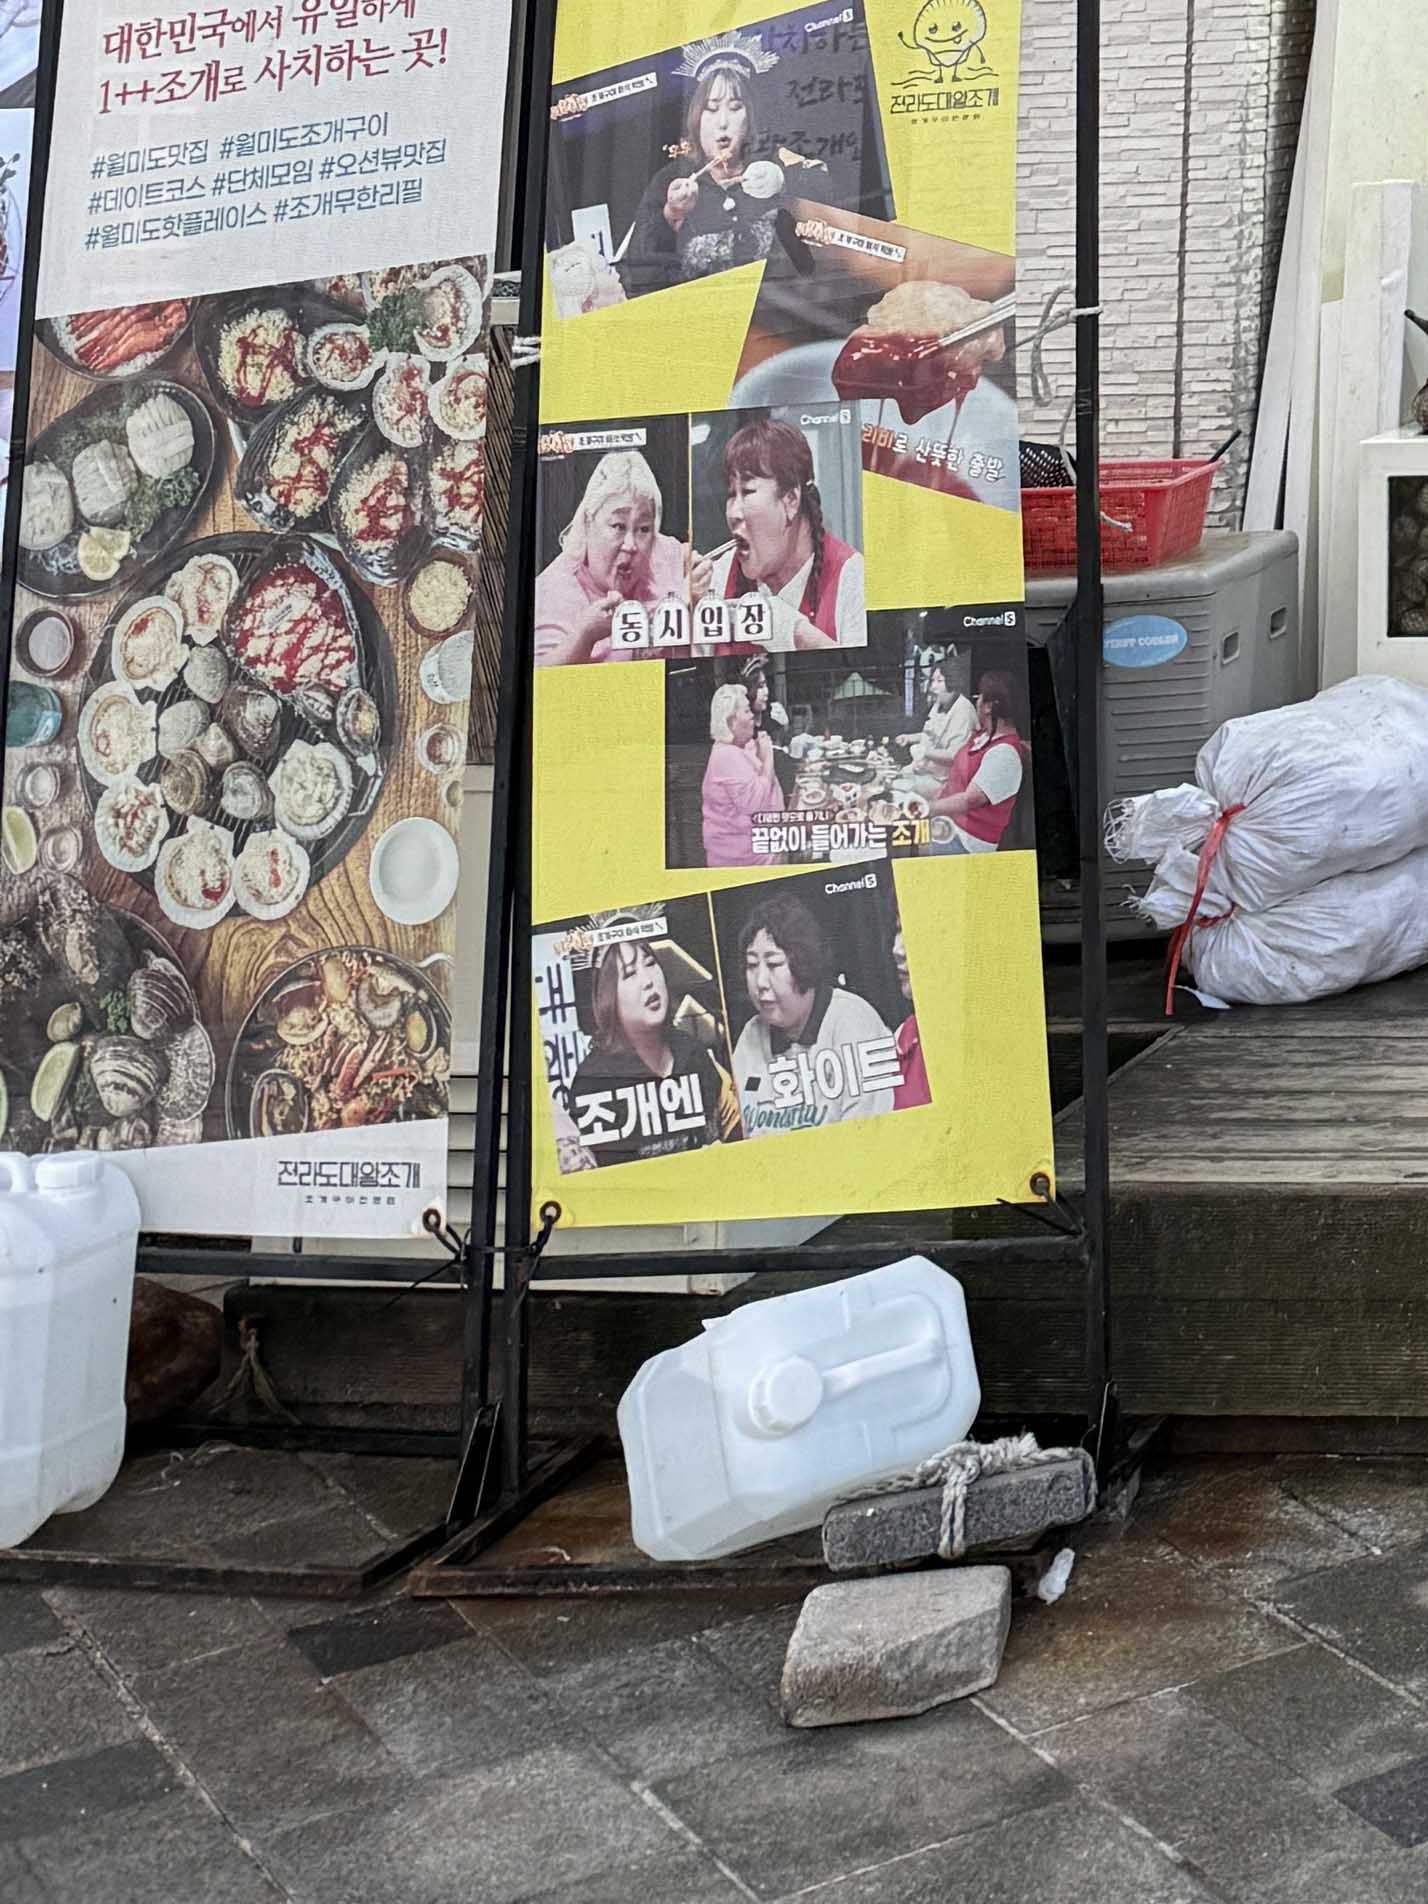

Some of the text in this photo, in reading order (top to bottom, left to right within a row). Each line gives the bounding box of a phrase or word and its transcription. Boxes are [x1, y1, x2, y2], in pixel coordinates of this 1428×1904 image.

[99, 27, 449, 114] 1++조개로 사치하는 곳!
[103, 5, 284, 64] 대한민국에서
[88, 138, 447, 216] #데이트코스 #단체모임 #오션뷰맛집
[91, 111, 389, 180] #월미도맛집 #월미도조개구이
[84, 176, 424, 251] #월미도핫플레이스 #조개무한리필
[862, 423, 909, 454] 리비로
[751, 819, 930, 854] 끝없이 들어가는 조개
[766, 1035, 905, 1110] 화이트
[575, 1072, 706, 1147] 조개엔
[277, 1159, 421, 1189] 전라도대왕조개
